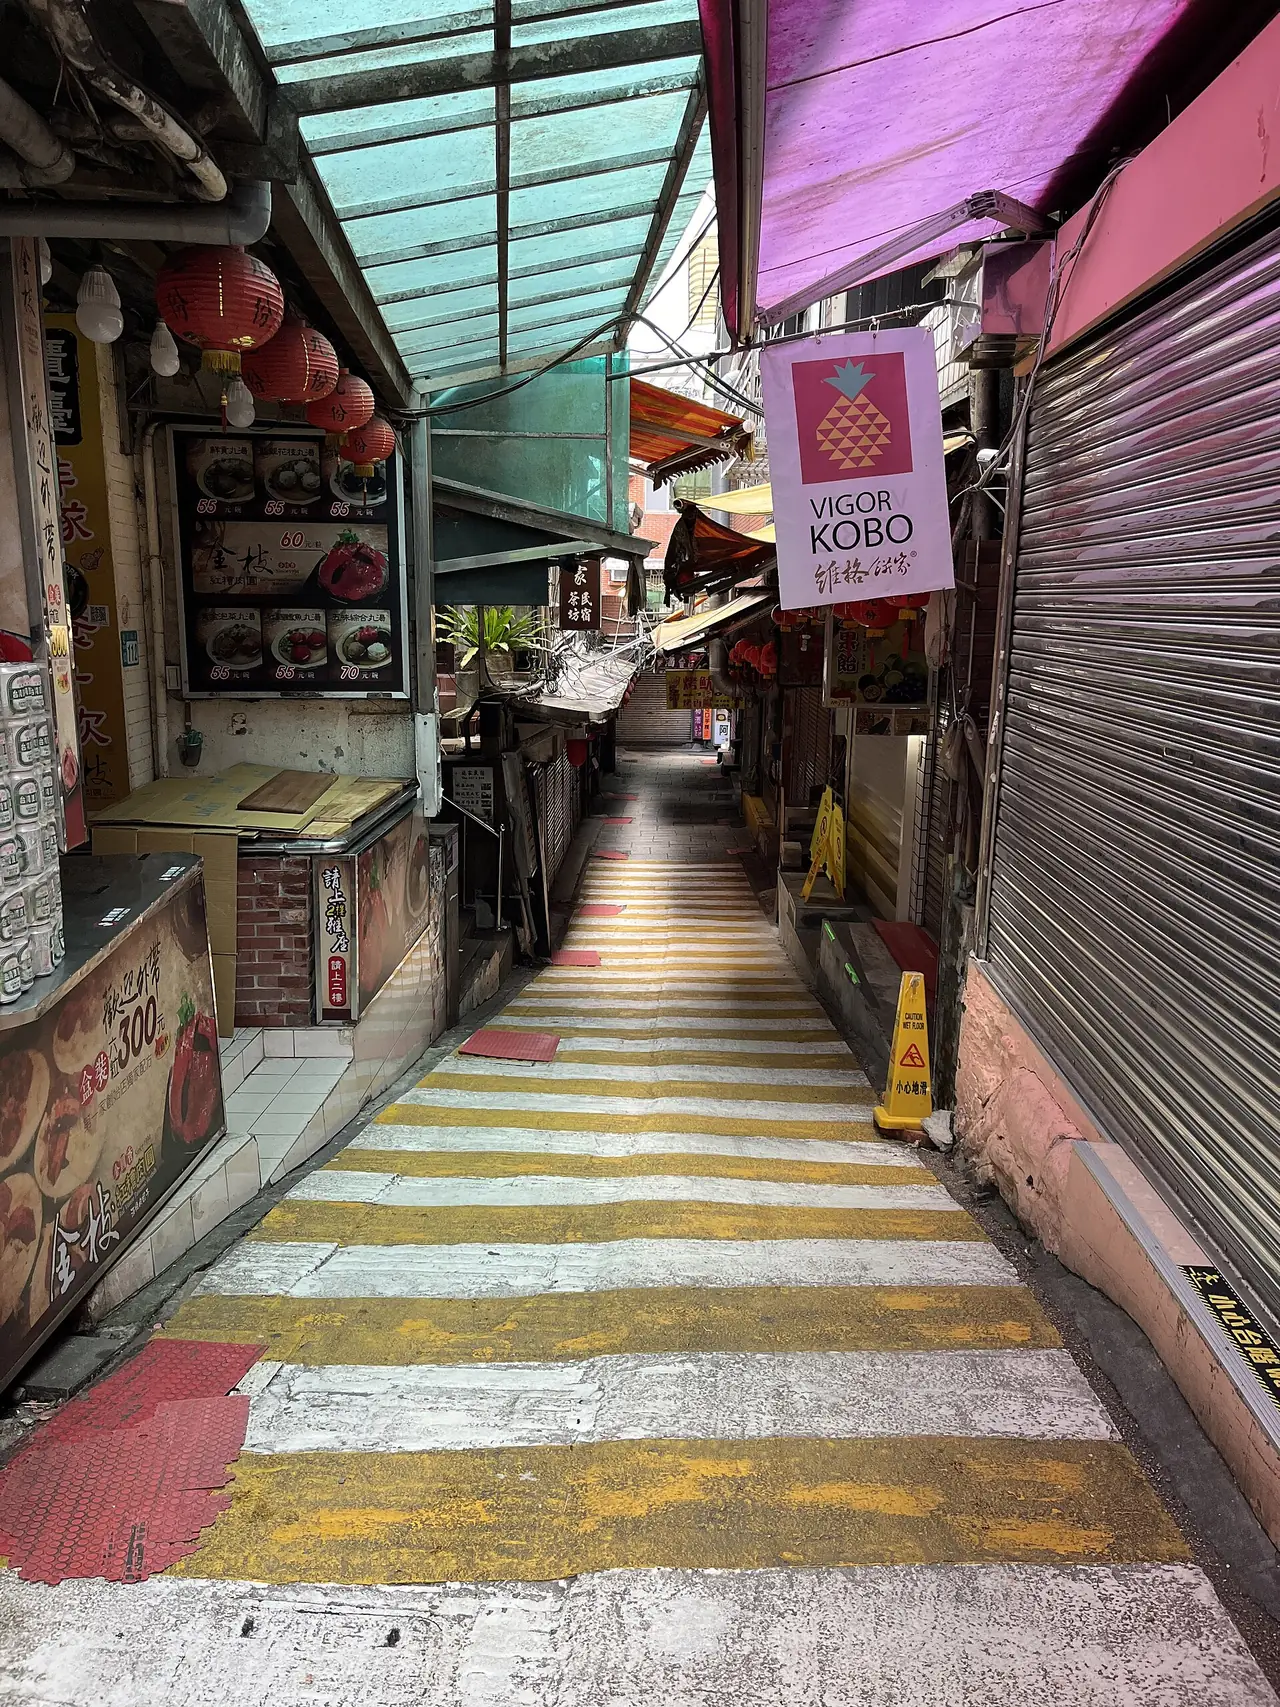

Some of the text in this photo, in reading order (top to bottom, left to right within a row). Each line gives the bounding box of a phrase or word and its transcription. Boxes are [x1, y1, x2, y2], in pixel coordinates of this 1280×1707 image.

[196, 499, 217, 514] 55
[264, 500, 285, 515] 55
[329, 502, 350, 517] 55
[809, 490, 892, 520] VIGOR
[279, 530, 305, 549] 60
[810, 513, 914, 555] KOBO
[567, 591, 580, 622] 茶坊
[580, 591, 593, 622] 民宿
[210, 665, 231, 679] 55
[275, 665, 295, 679] 55
[340, 665, 360, 679] 70
[102, 937, 161, 1034] 歡迎外帶
[330, 960, 343, 1003] 請上二樓
[902, 1022, 925, 1030] WET FLOOR
[904, 1012, 923, 1021] CAUTION
[118, 994, 157, 1070] 300
[157, 1012, 166, 1035] 元
[896, 1079, 928, 1096] 小心地滑
[50, 1180, 120, 1302] 金枝
[1207, 1293, 1280, 1365] 小心台階
